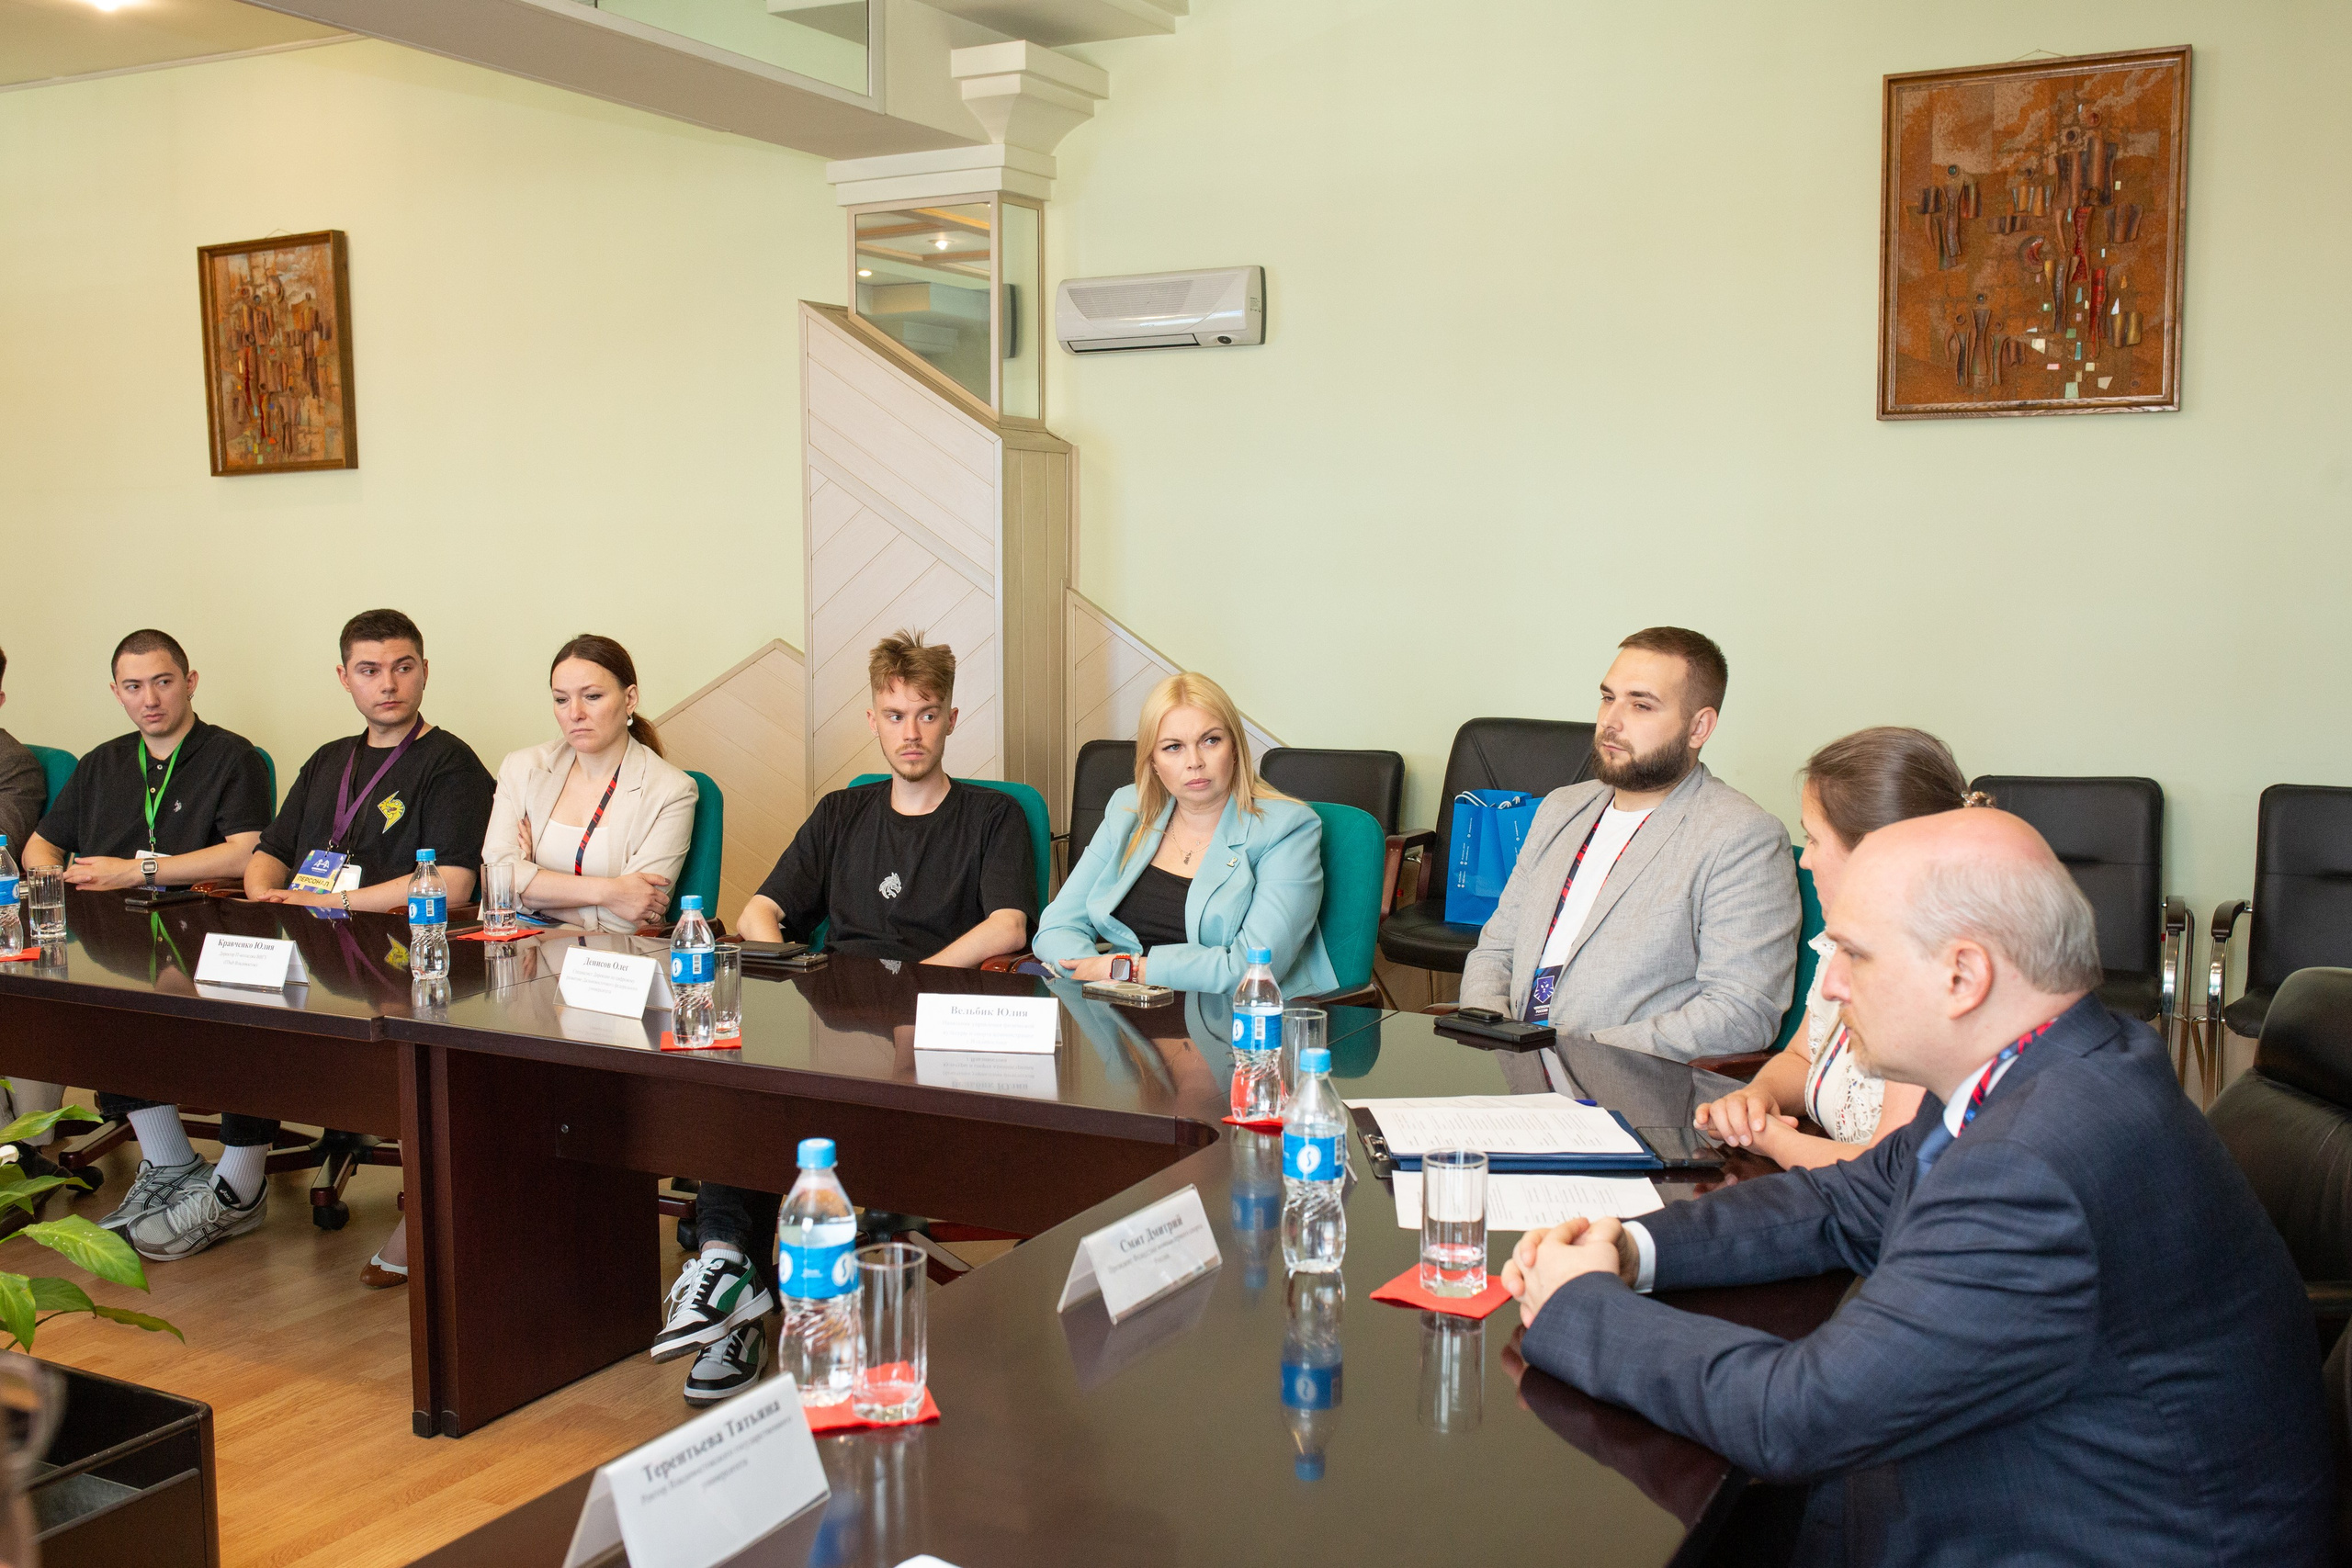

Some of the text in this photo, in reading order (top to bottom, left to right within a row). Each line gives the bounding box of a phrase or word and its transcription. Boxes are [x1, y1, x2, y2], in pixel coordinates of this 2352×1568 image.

[297, 875, 330, 887] ПЕРСОНАЛ
[218, 938, 275, 951] Кравченко Юлия
[583, 957, 629, 971] Денисов Олег
[951, 1006, 1028, 1017] Вельбик Юлия
[1119, 1235, 1145, 1253] Смит
[1145, 1214, 1183, 1243] Дмитрий
[642, 1431, 724, 1483] Терентьева
[724, 1399, 781, 1438] Татьяна
